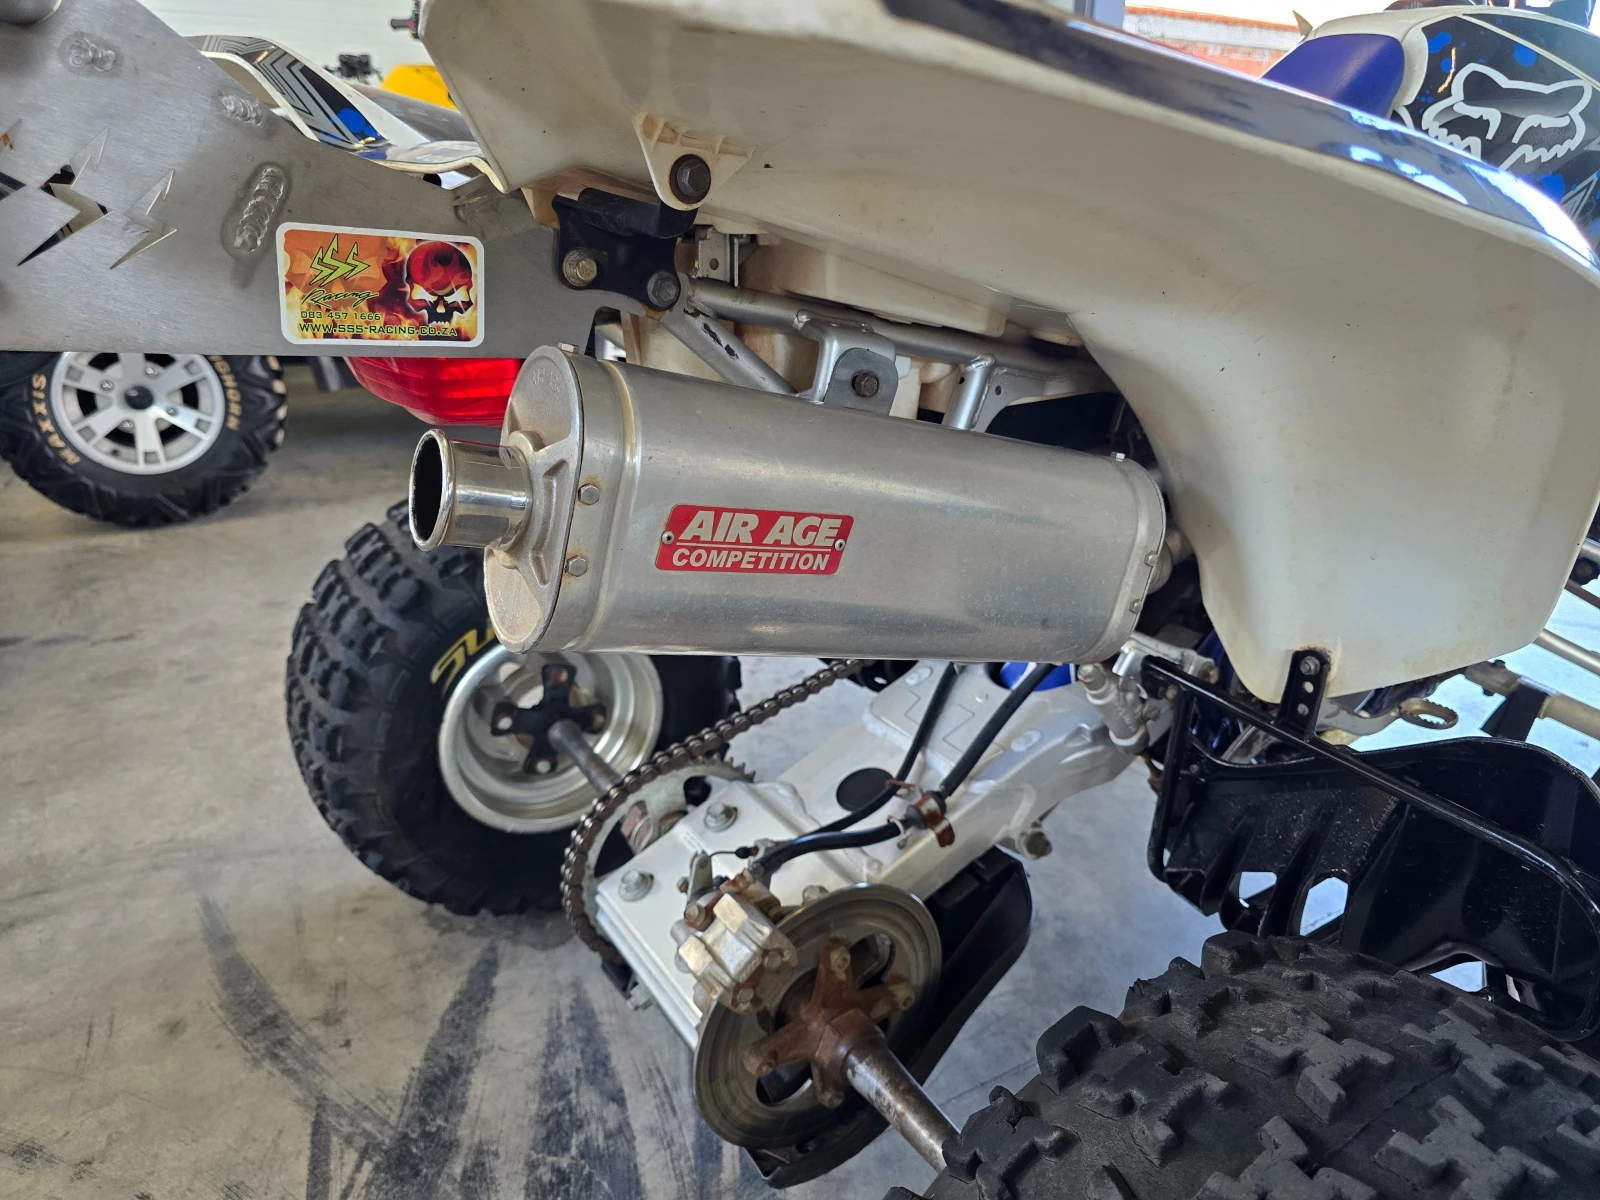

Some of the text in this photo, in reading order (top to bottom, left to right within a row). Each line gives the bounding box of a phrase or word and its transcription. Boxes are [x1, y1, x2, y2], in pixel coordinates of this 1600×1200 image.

[301, 288, 379, 309] Racing
[300, 311, 381, 321] 083 457 1666
[299, 323, 458, 337] WWW.SSS-RACING.CO.ZA
[31, 374, 81, 466] MAXXIS
[678, 510, 843, 547] AIR AGE
[672, 548, 830, 571] COMPETITION
